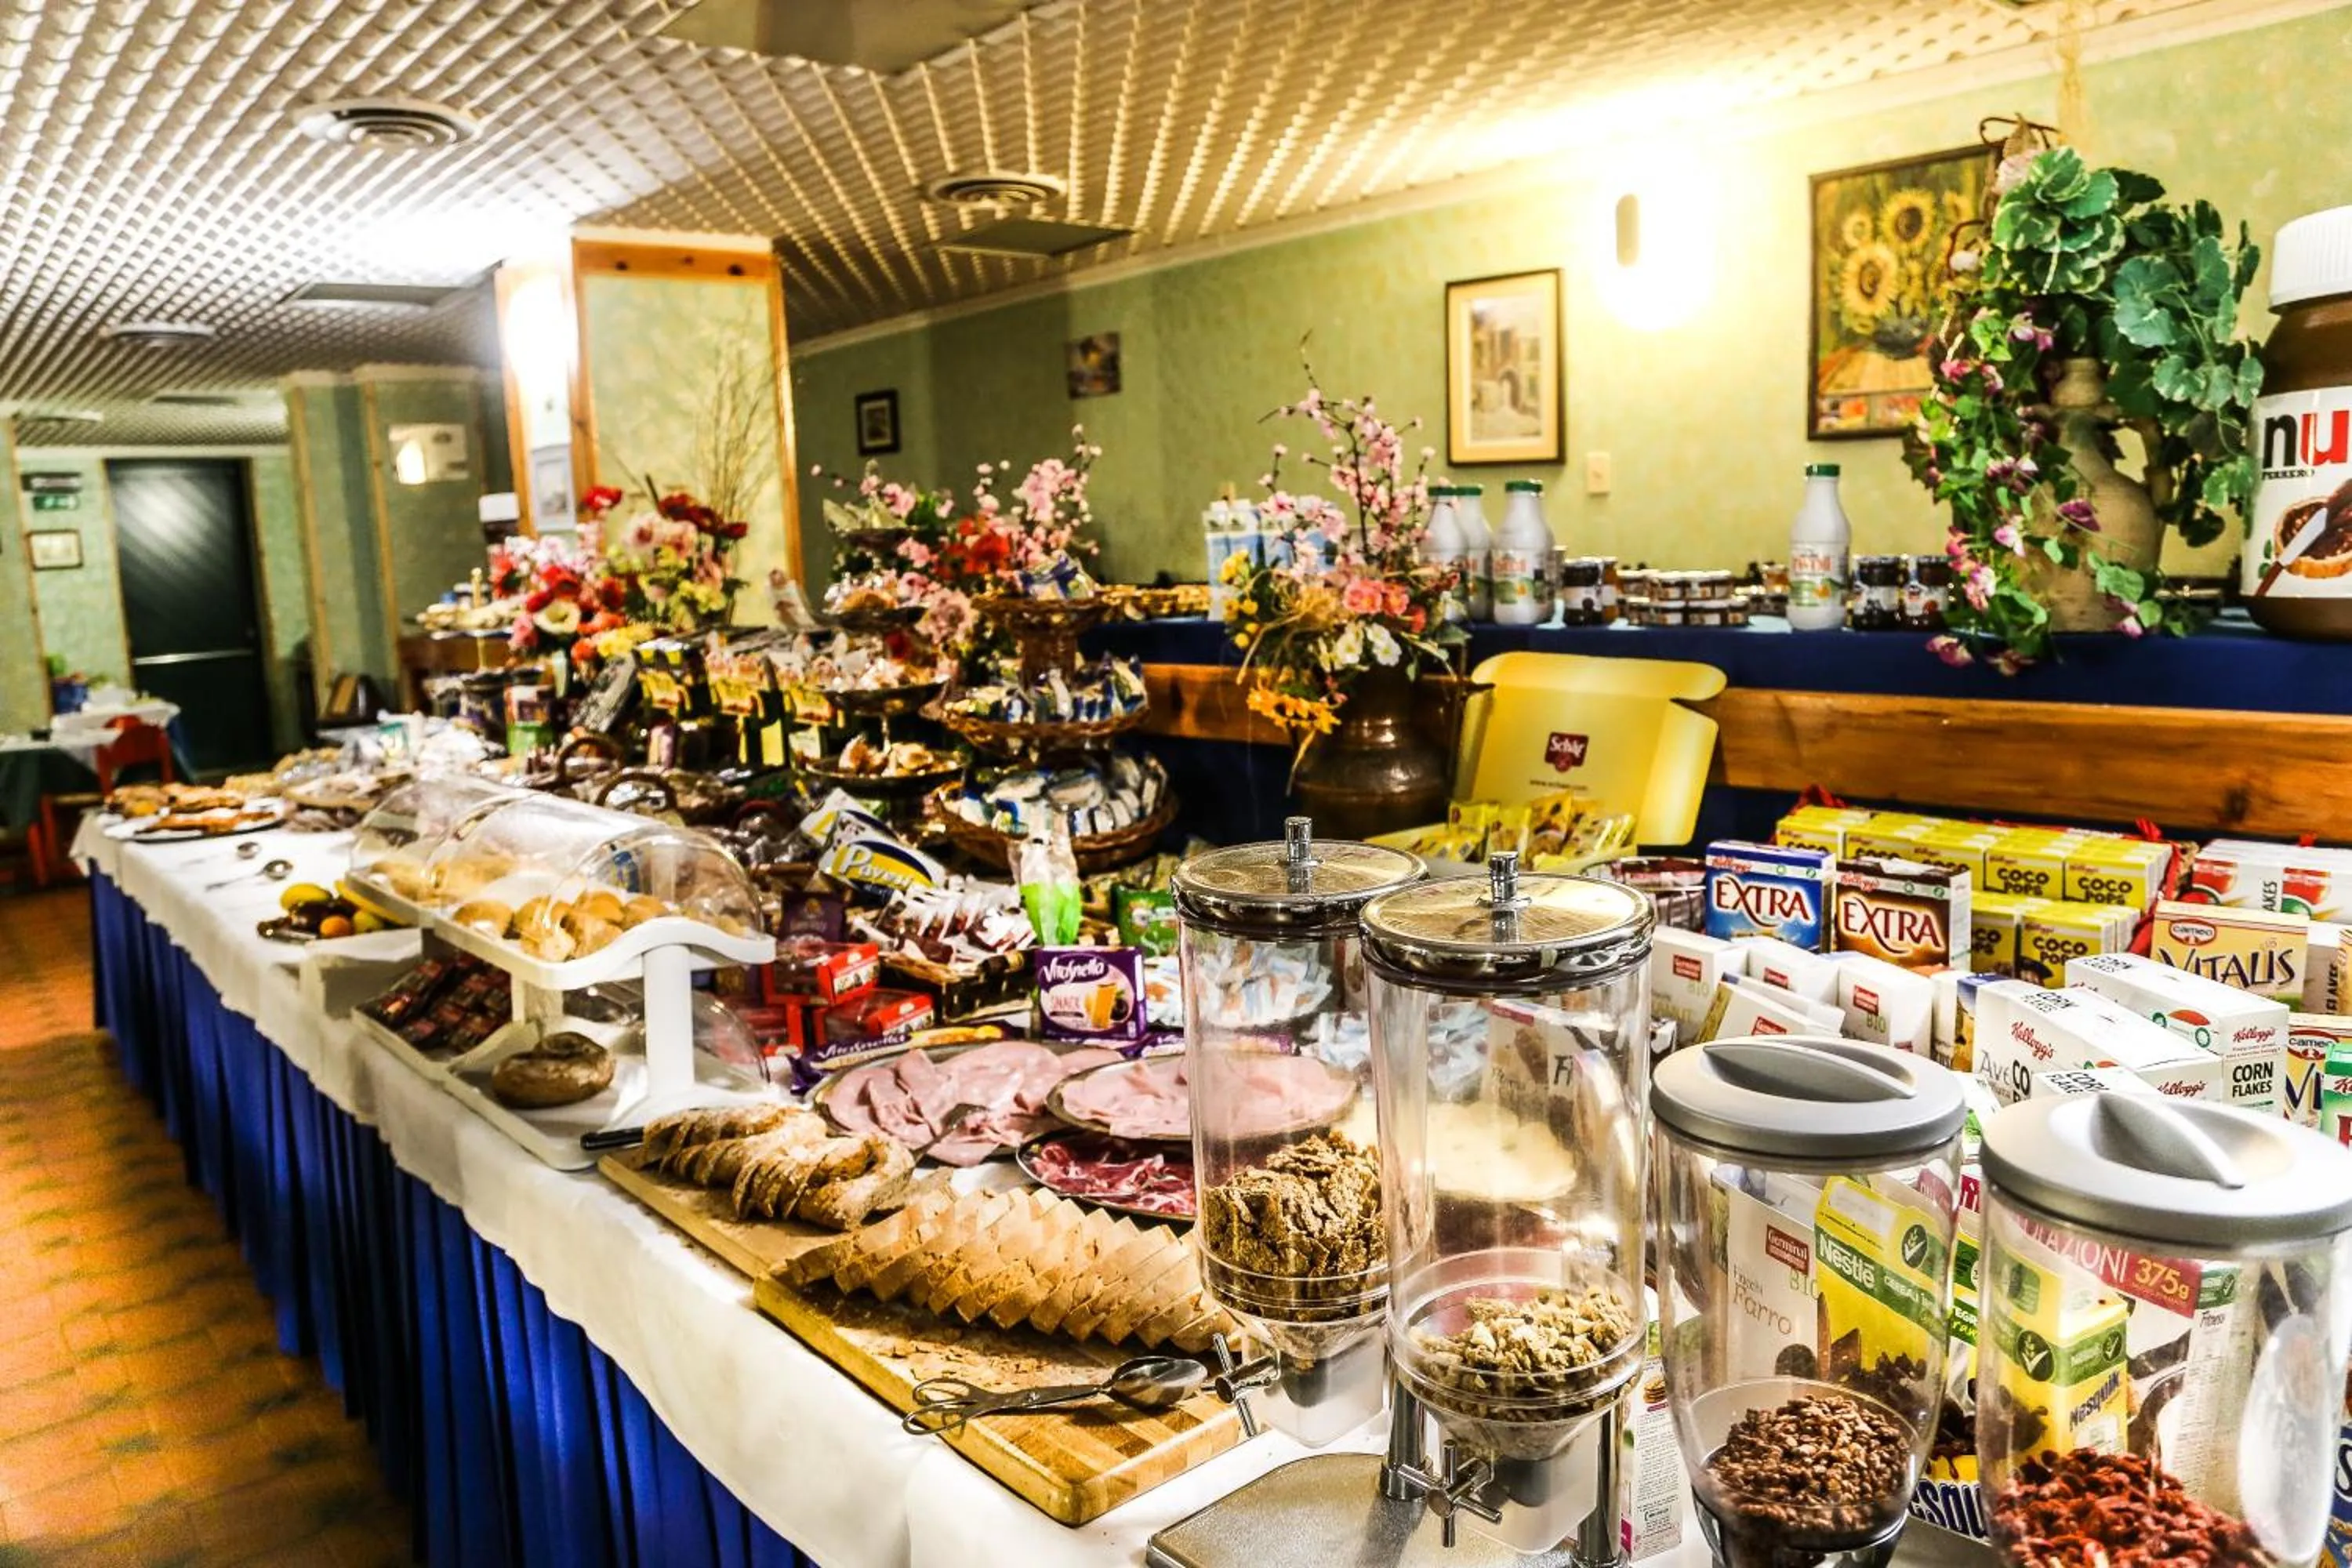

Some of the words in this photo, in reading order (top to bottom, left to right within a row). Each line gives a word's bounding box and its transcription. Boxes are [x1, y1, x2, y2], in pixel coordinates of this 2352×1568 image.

[1997, 868, 2049, 884] COCO
[2078, 877, 2132, 894] COCO
[1715, 876, 1811, 927] EXTRA
[1843, 897, 1944, 954] EXTRA
[2033, 936, 2089, 955] COCO
[2159, 947, 2296, 989] VITALIS
[2011, 1020, 2056, 1061] Kellogg's
[2231, 1025, 2276, 1044] Kellogg's
[2232, 1061, 2274, 1083] CORN
[2232, 1080, 2272, 1098] FLAKES
[1819, 1233, 1875, 1289] Nestlé
[1733, 1283, 1792, 1335] Farro
